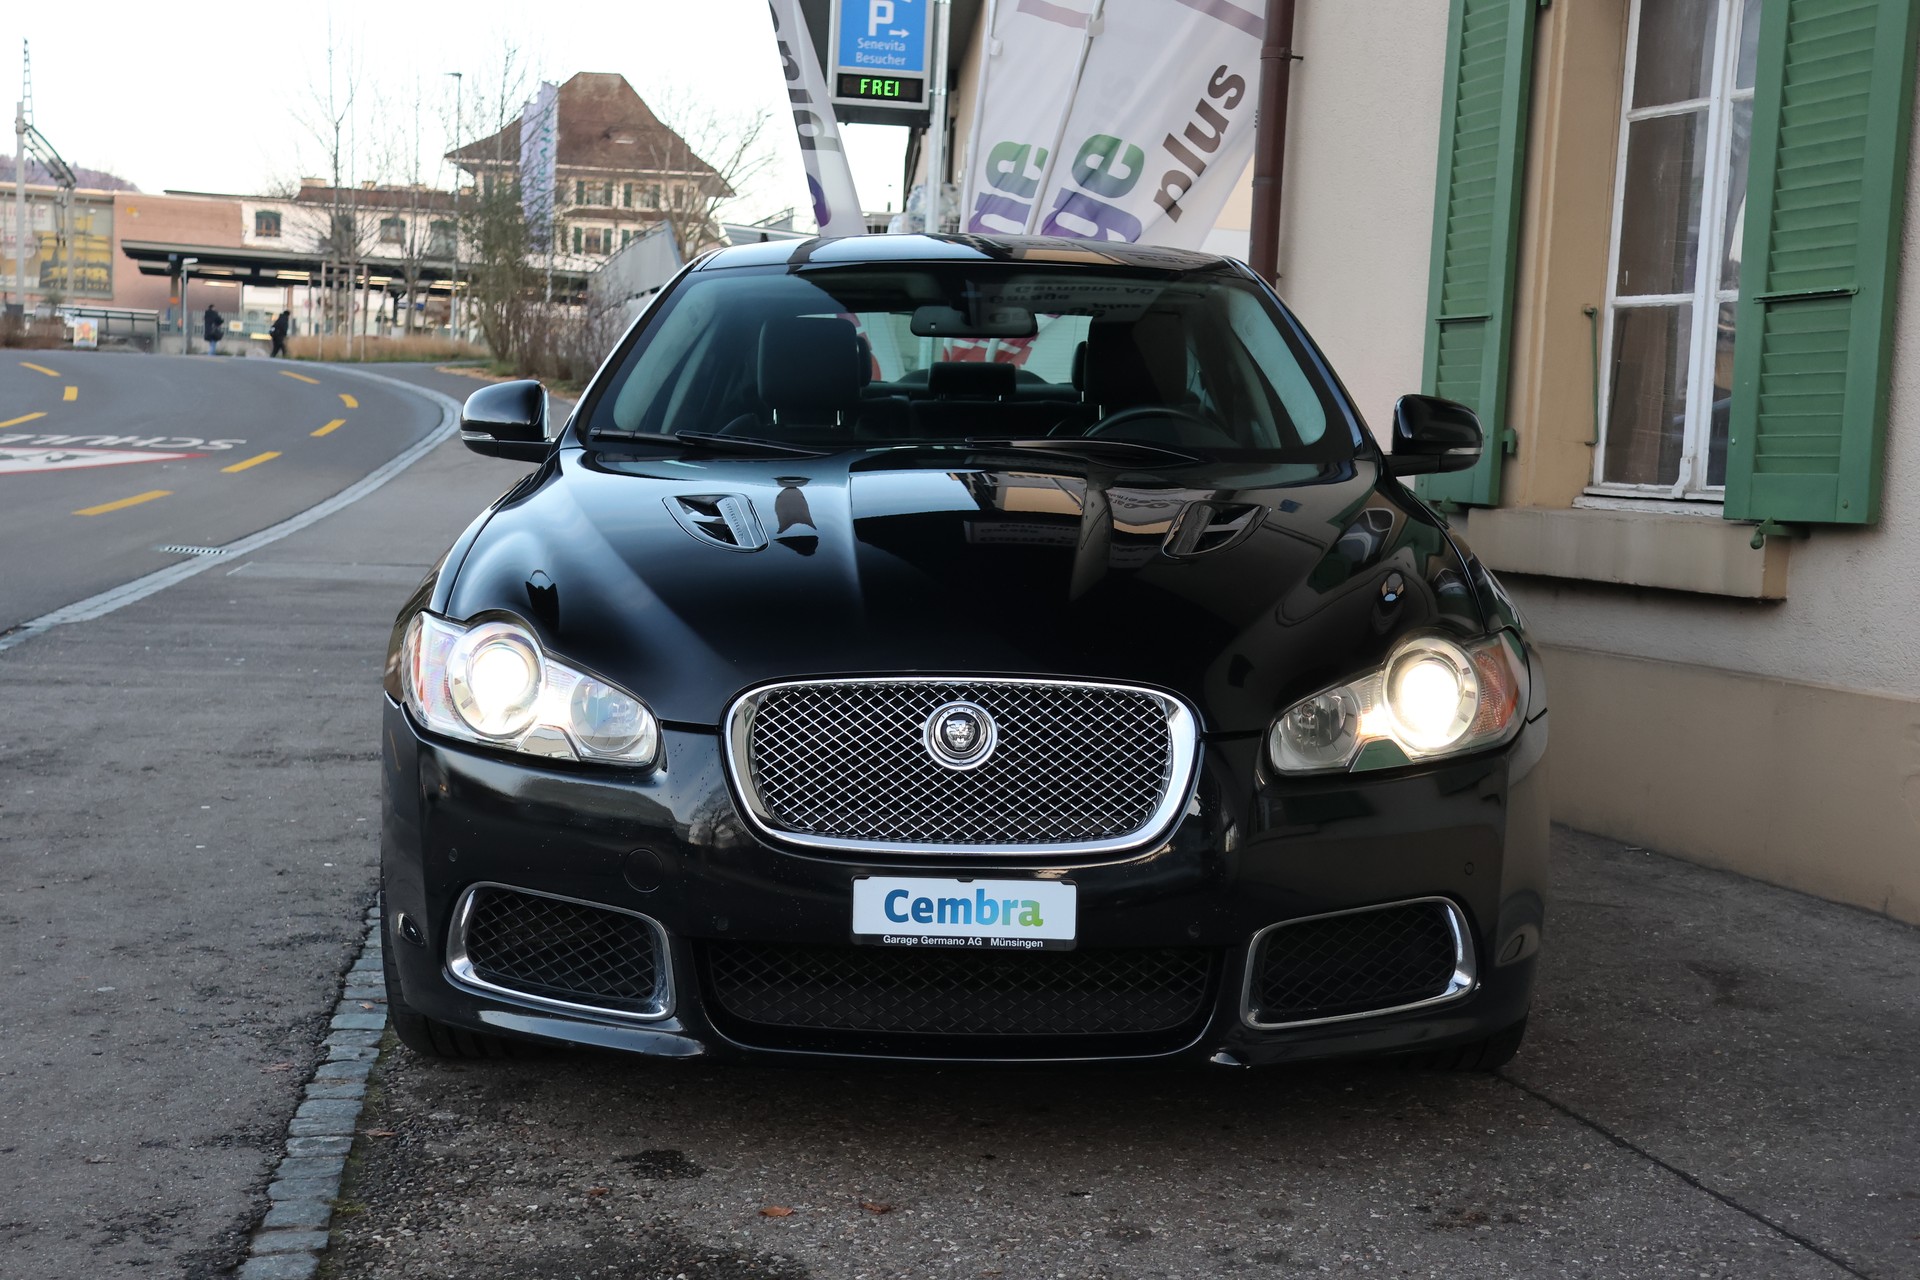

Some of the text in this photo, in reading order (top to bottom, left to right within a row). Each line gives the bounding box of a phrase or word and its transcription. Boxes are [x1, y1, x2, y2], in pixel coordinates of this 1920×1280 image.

[867, 0, 895, 37] P
[855, 51, 906, 66] Besucher
[856, 37, 906, 52] Senevita
[769, 0, 840, 152] plu
[859, 78, 901, 97] FREI
[1153, 64, 1246, 223] plus
[884, 888, 1044, 927] Cembra
[883, 934, 1043, 948] Garage Germano AG Münsingen
